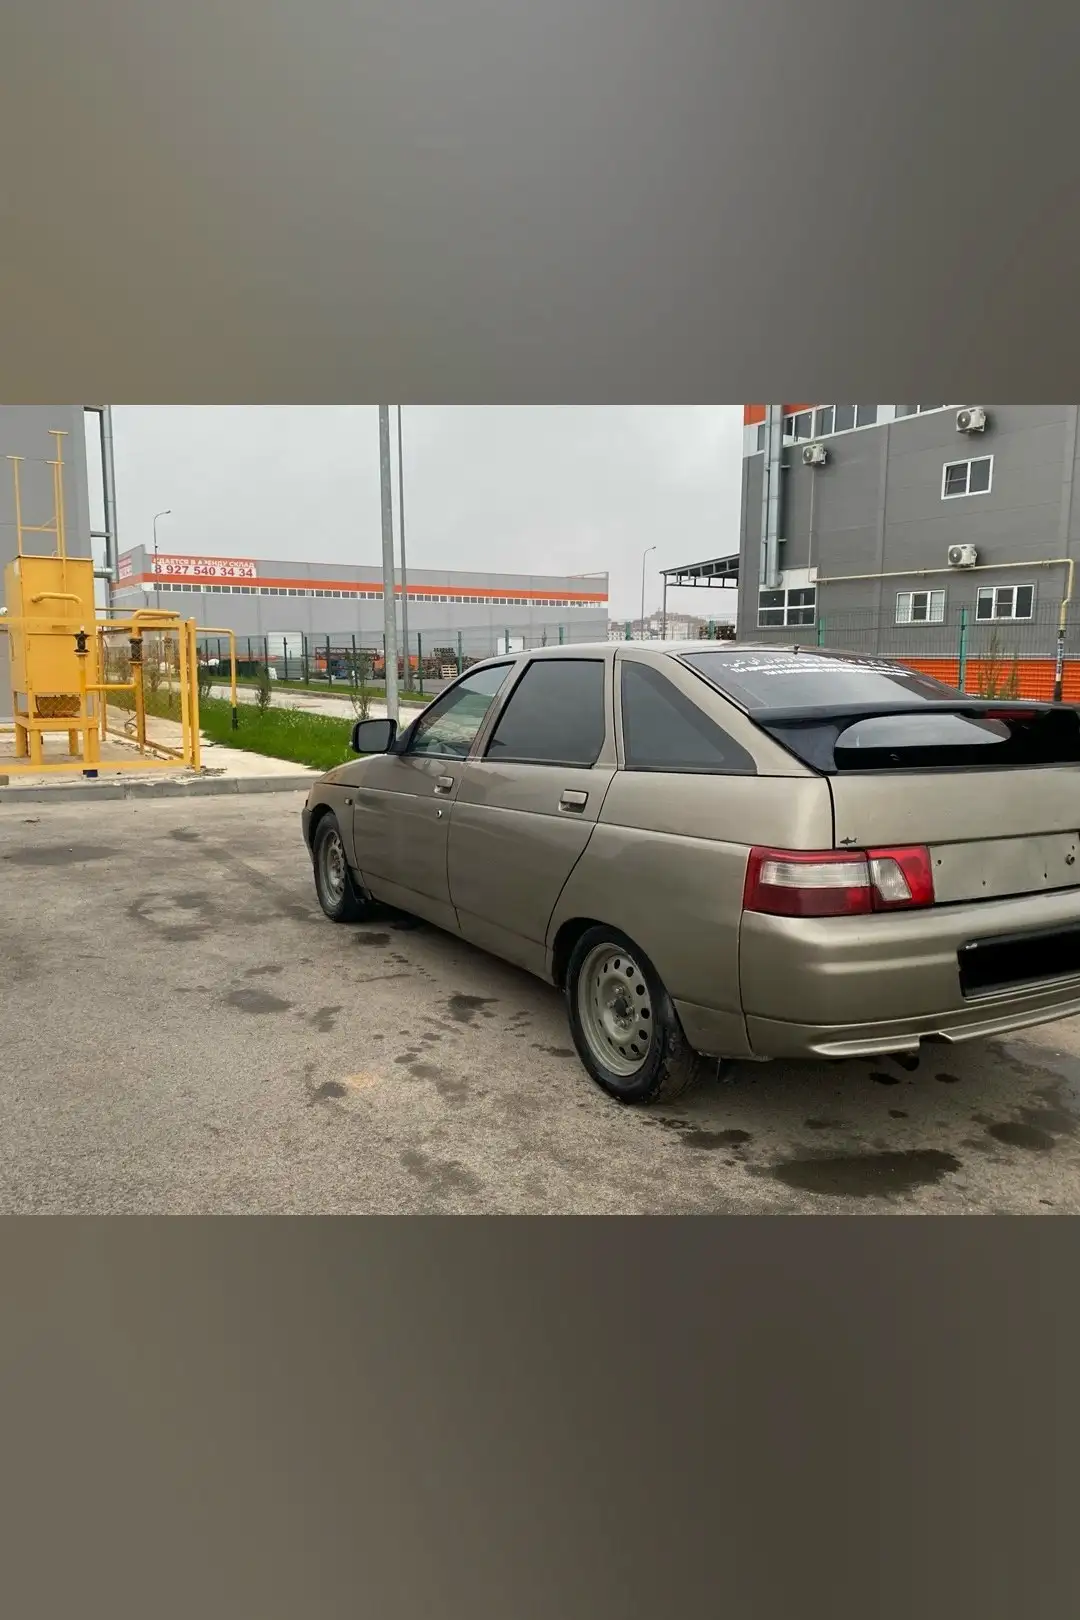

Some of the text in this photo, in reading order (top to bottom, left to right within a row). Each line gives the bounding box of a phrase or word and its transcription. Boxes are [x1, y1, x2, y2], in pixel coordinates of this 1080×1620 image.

[155, 565, 254, 577] 8 927 540 34 34
